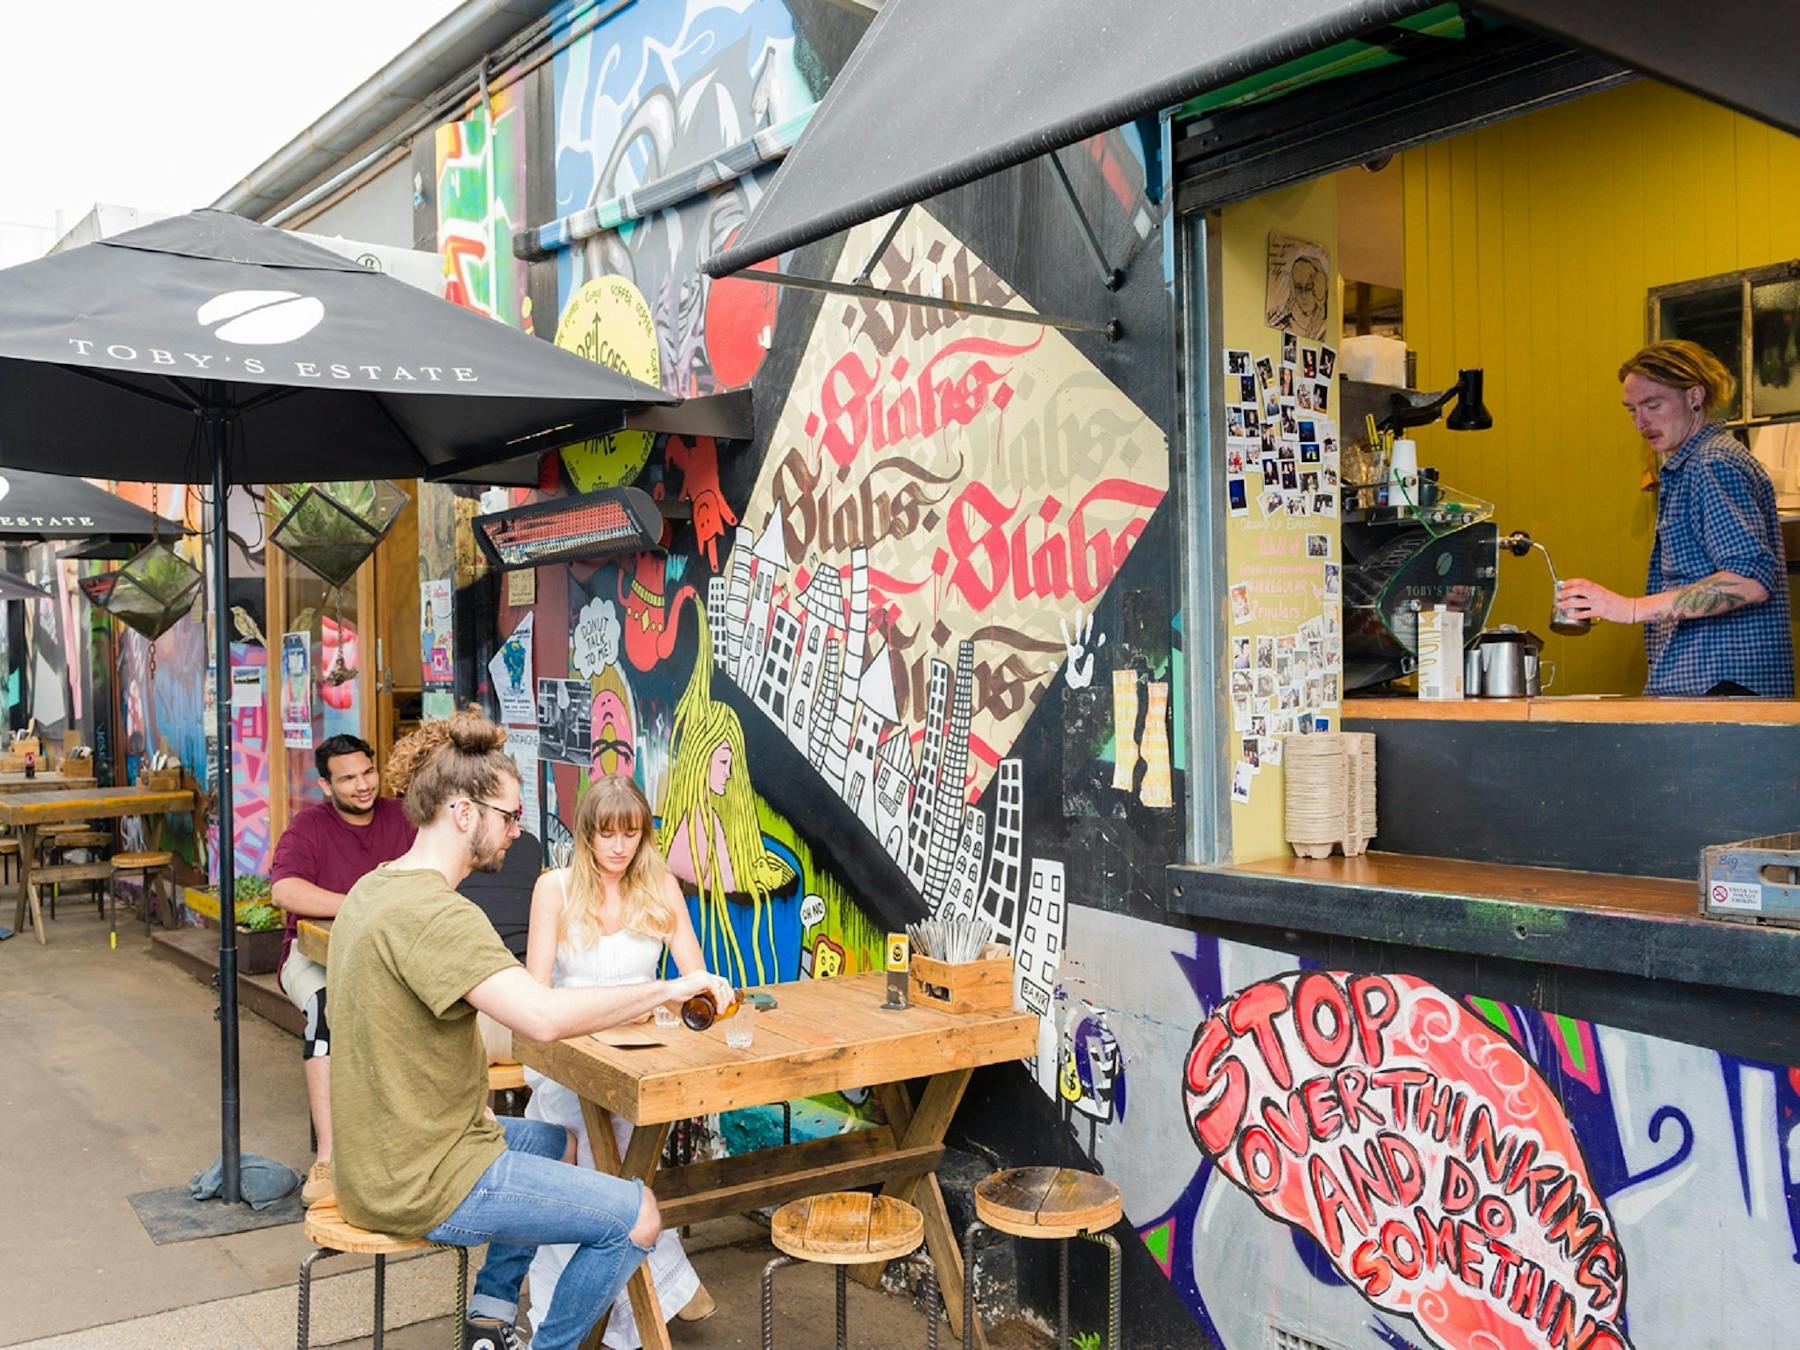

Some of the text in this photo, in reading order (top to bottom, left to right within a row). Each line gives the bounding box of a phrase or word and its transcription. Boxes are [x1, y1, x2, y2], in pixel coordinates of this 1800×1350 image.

[68, 338, 479, 382] TOBY'S ESTATE
[0, 516, 94, 527] ESTATE
[1405, 585, 1442, 597] TOBY'S
[581, 616, 609, 639] DONUT
[586, 632, 606, 651] TALK
[585, 652, 595, 666] TO
[1023, 982, 1047, 1010] BANK
[1181, 972, 1400, 1157] STOP
[1307, 1129, 1517, 1259] AND DO
